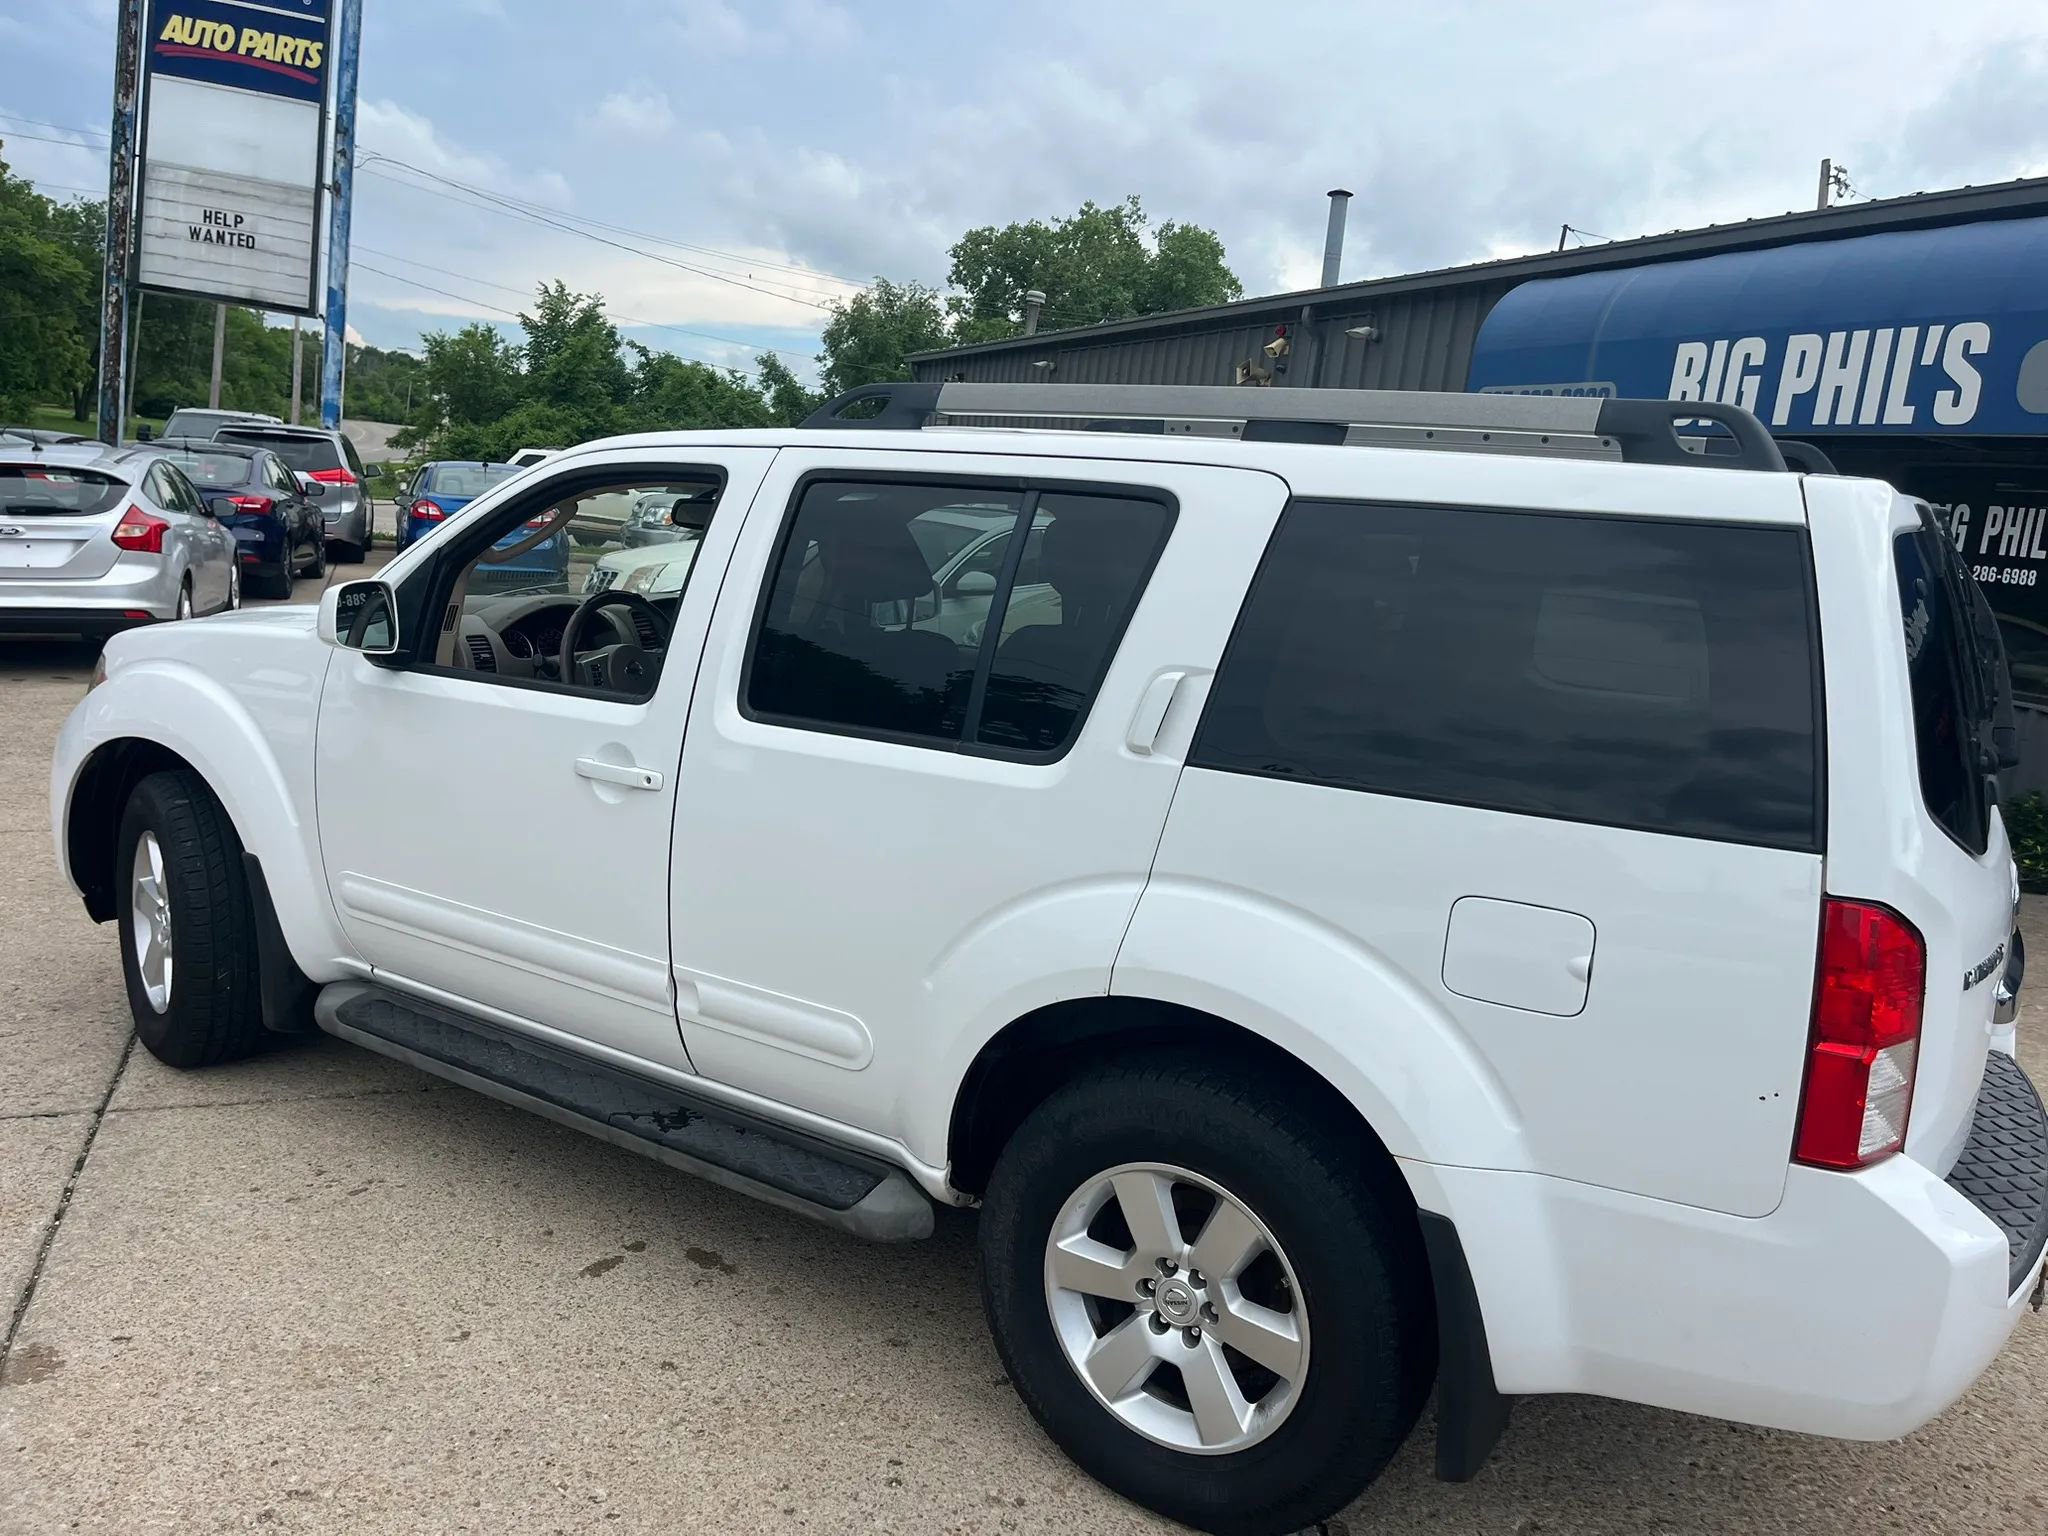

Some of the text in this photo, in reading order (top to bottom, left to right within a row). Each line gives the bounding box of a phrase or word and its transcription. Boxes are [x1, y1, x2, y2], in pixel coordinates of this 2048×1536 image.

[160, 15, 323, 69] AUTO PARTS
[203, 209, 244, 228] HELP
[189, 225, 255, 249] WANTED
[1667, 321, 1991, 426] BIG PHIL'S
[1972, 564, 2037, 586] 286-6988
